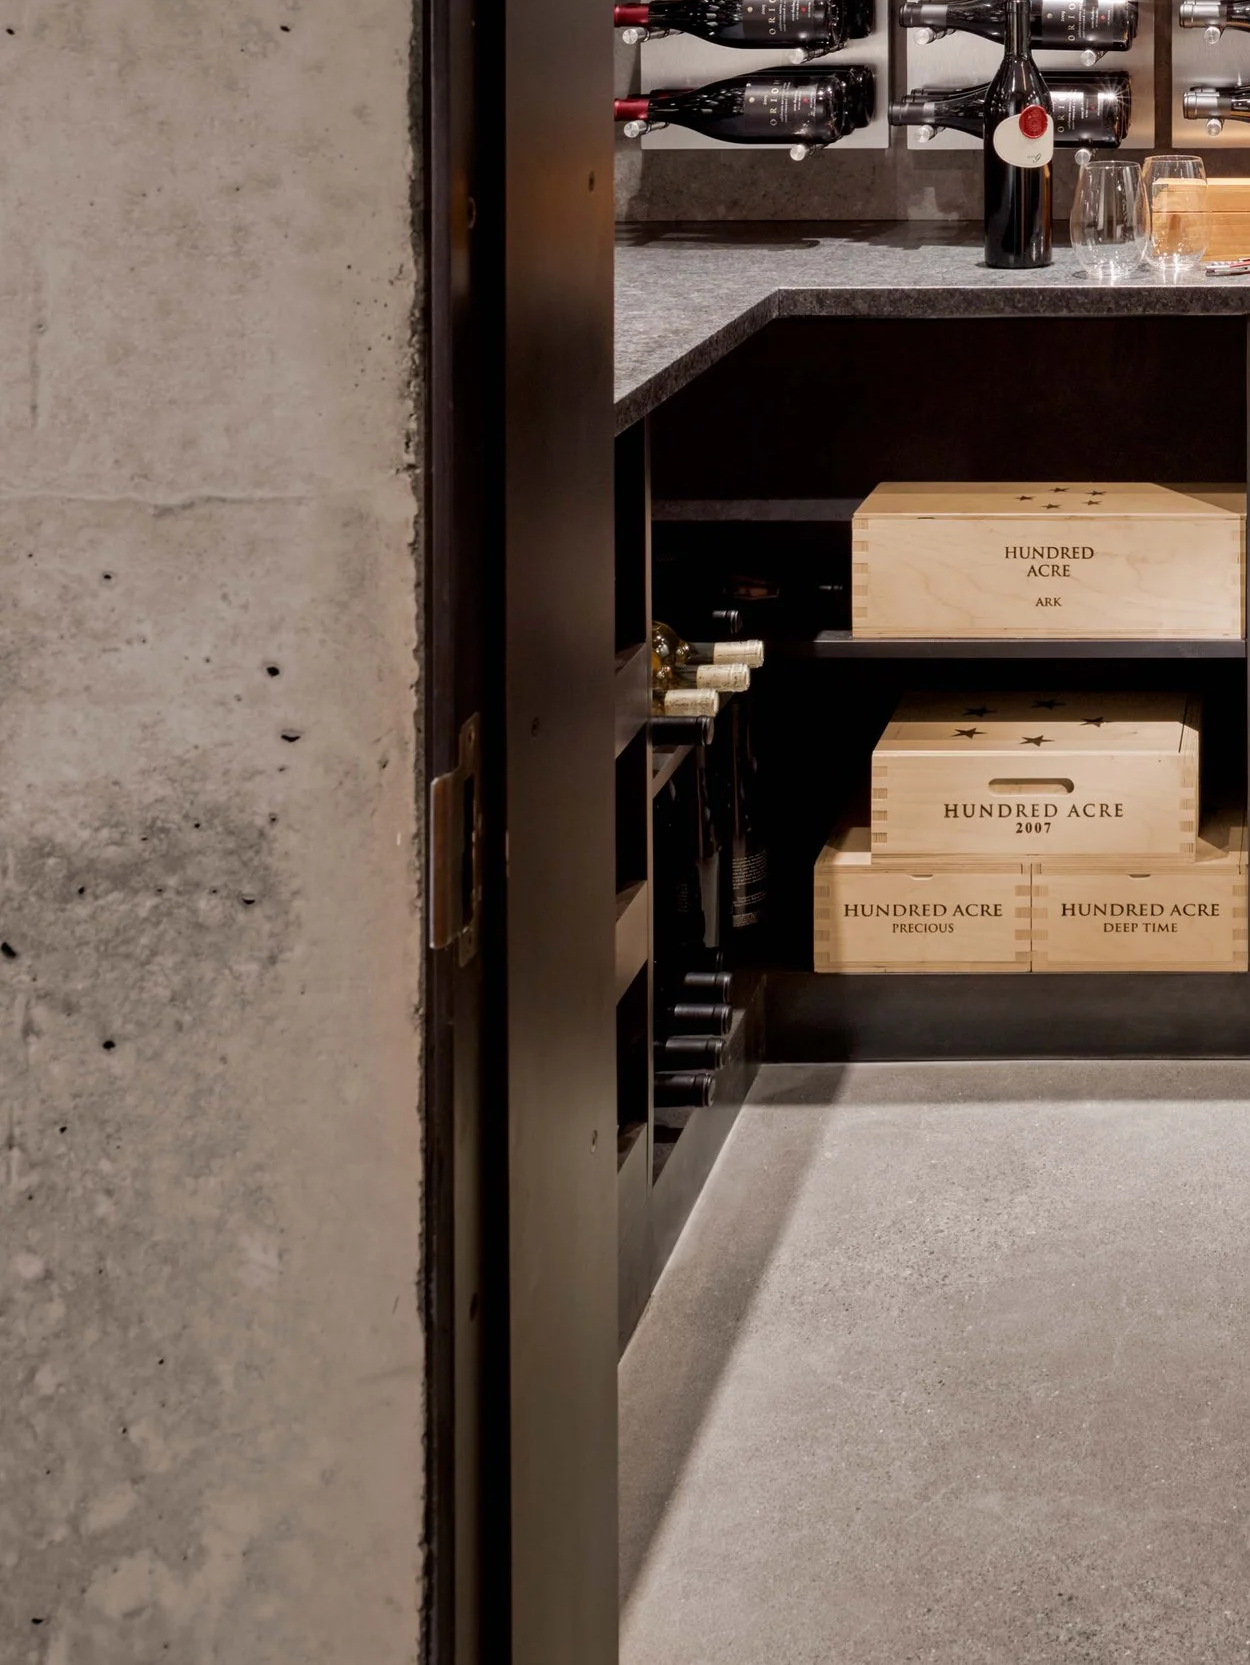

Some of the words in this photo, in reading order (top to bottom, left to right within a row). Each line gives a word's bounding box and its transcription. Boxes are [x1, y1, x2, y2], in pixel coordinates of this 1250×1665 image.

[1068, 2, 1076, 41] ORIO
[1004, 545, 1095, 561] HUNDRED
[1026, 564, 1072, 579] ACRE
[1035, 597, 1062, 608] ARK
[943, 803, 1060, 819] HUNDRED
[1068, 803, 1125, 819] ACRE
[1015, 821, 1053, 835] 2007
[843, 903, 948, 918] HUNDRED
[952, 903, 1004, 917] ACRE
[1060, 902, 1166, 918] HUNDRED
[1170, 902, 1221, 917] ACRE
[892, 923, 955, 934] PRECIOUS
[1103, 922, 1140, 933] DEEP
[1142, 922, 1178, 933] TIME
